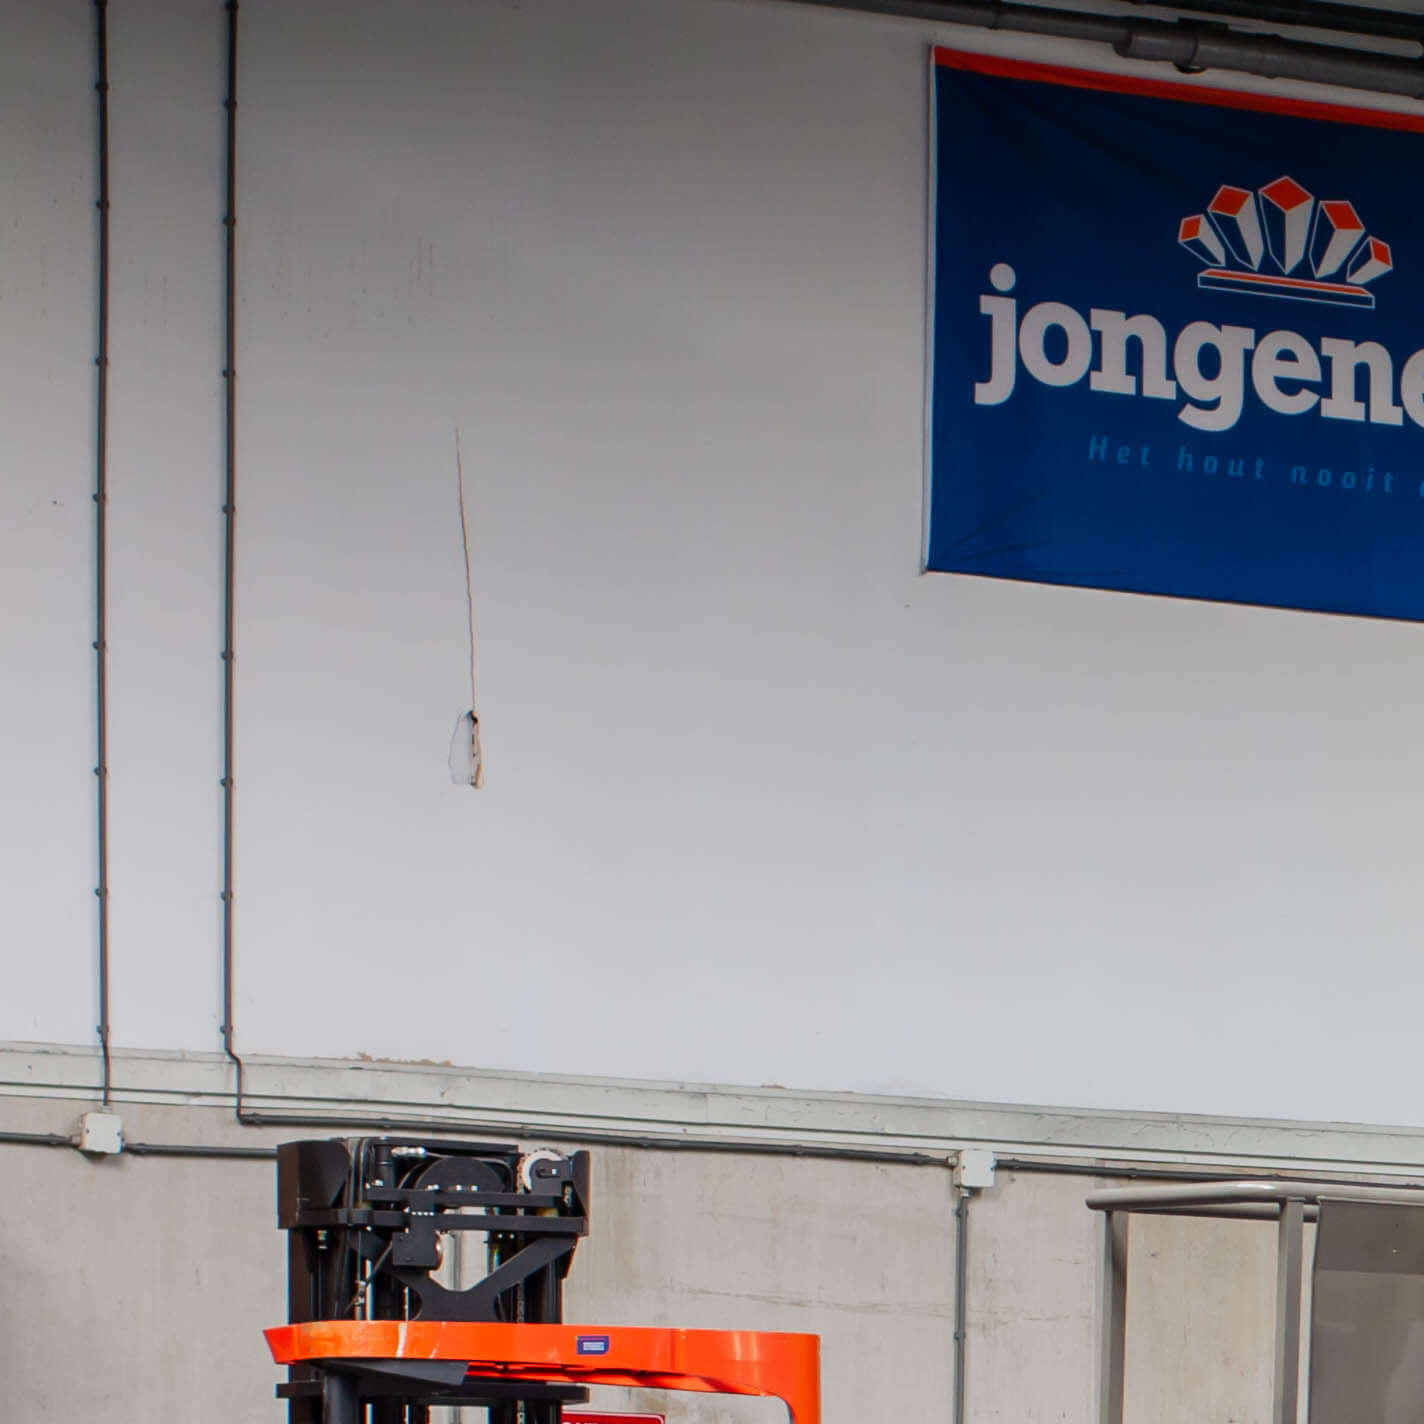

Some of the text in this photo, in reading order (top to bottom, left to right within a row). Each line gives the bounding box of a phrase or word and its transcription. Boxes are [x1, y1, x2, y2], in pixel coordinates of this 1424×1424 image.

[1088, 435, 1151, 467] Het
[1177, 445, 1265, 480] hout
[1290, 462, 1395, 494] nooit
